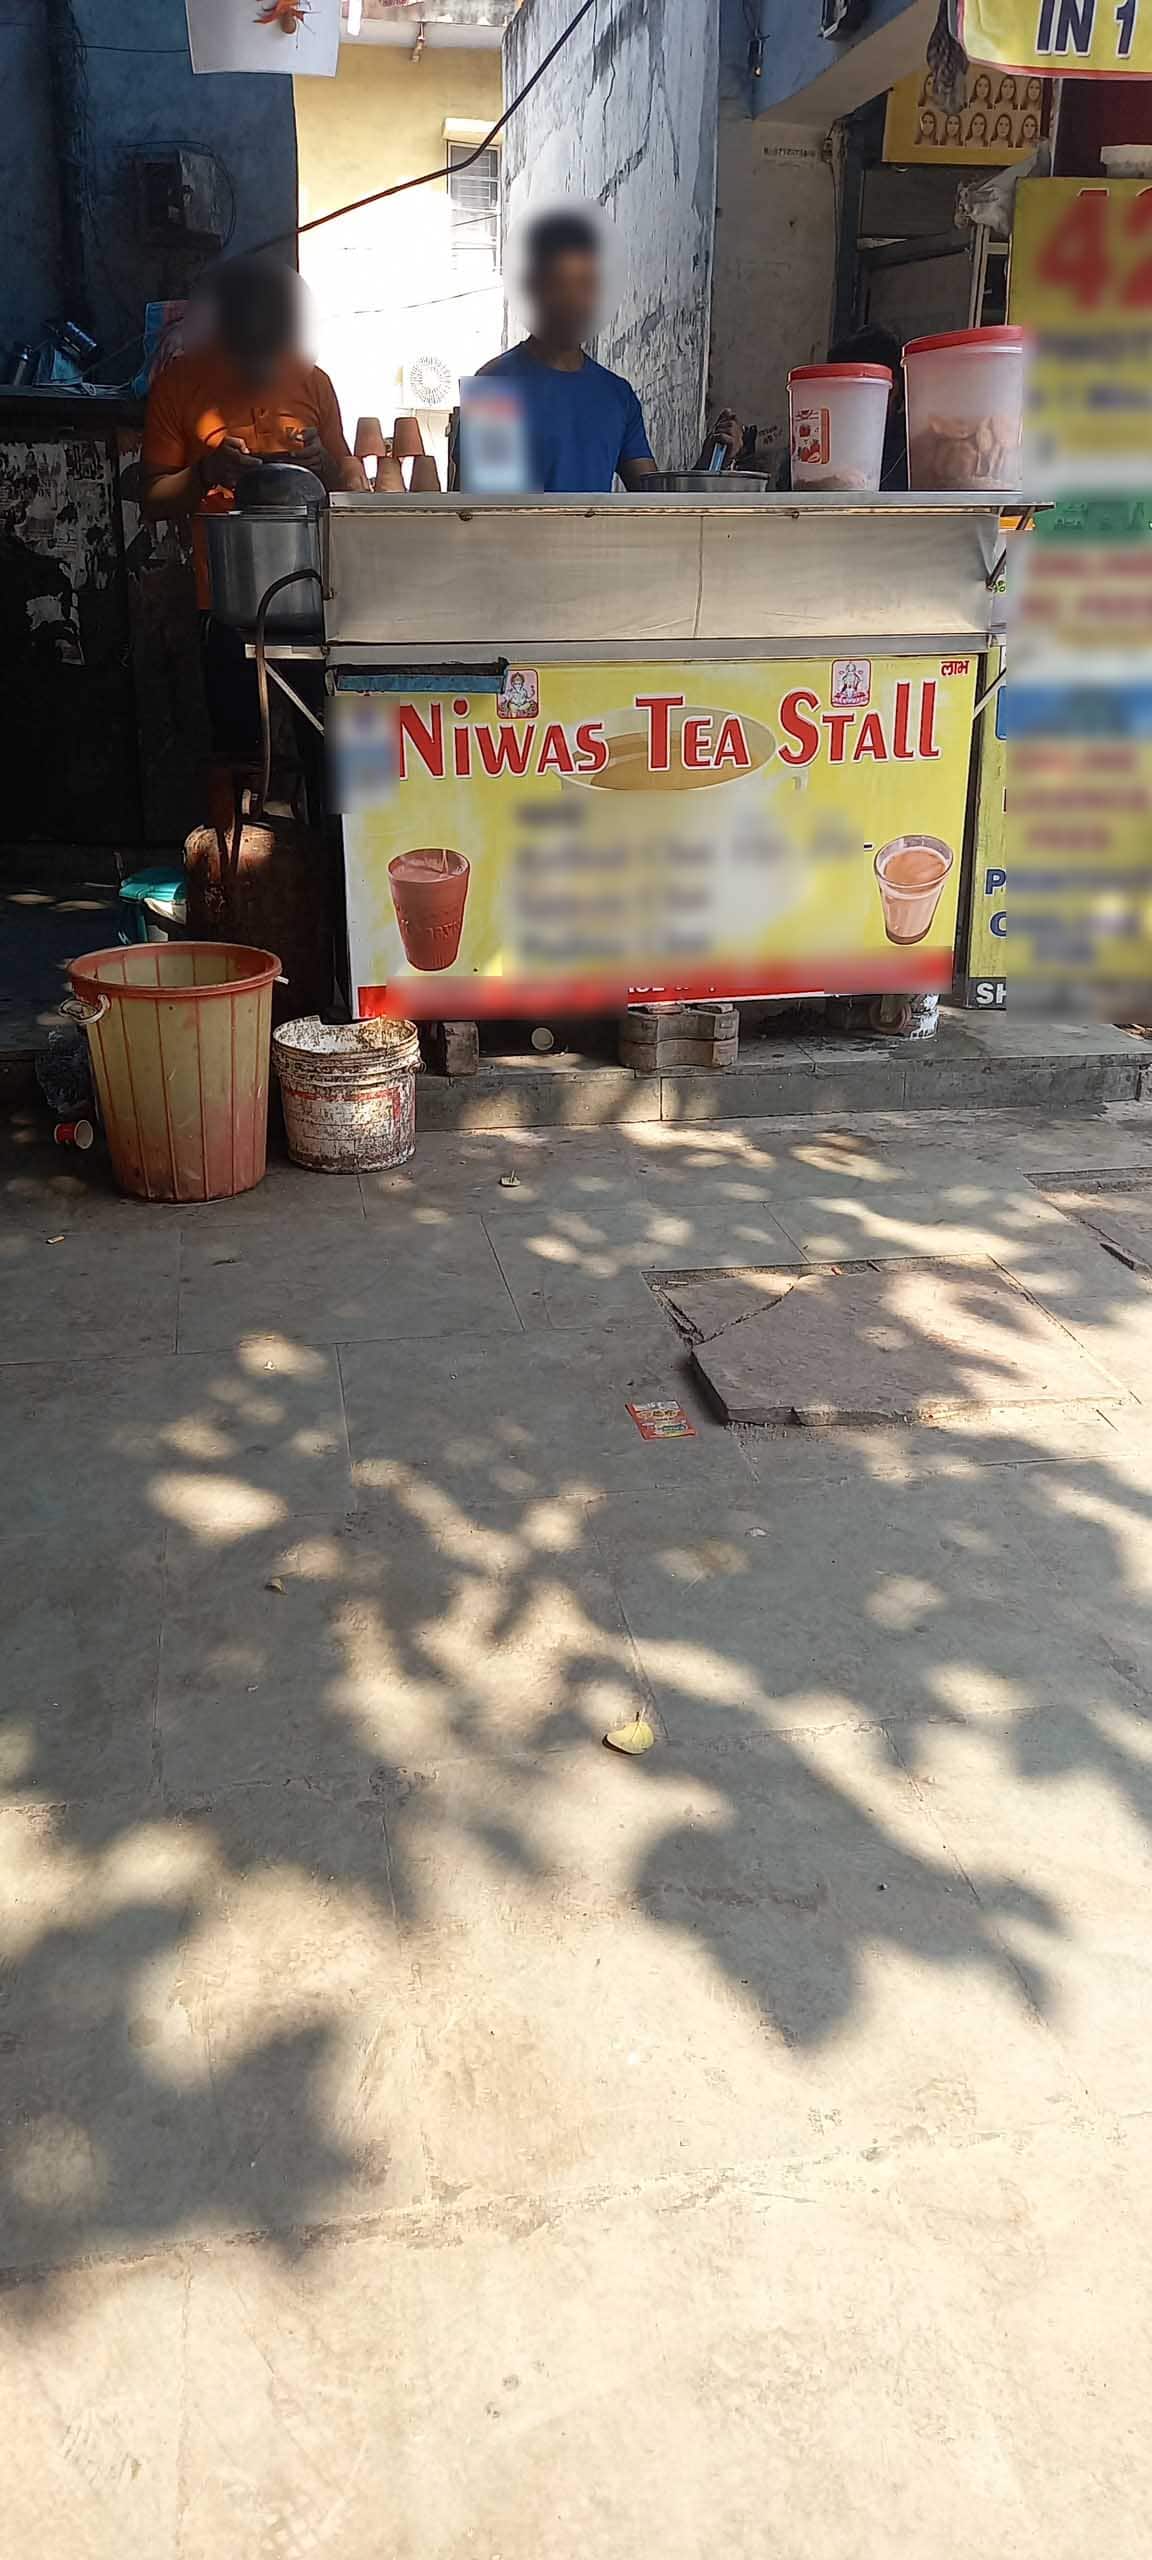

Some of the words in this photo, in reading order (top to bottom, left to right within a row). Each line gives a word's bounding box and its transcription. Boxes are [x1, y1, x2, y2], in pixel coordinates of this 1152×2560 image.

[1035, 0, 1096, 55] IN
[1114, 0, 1138, 57] 1
[940, 660, 970, 676] लाभ
[634, 694, 751, 771] TEA
